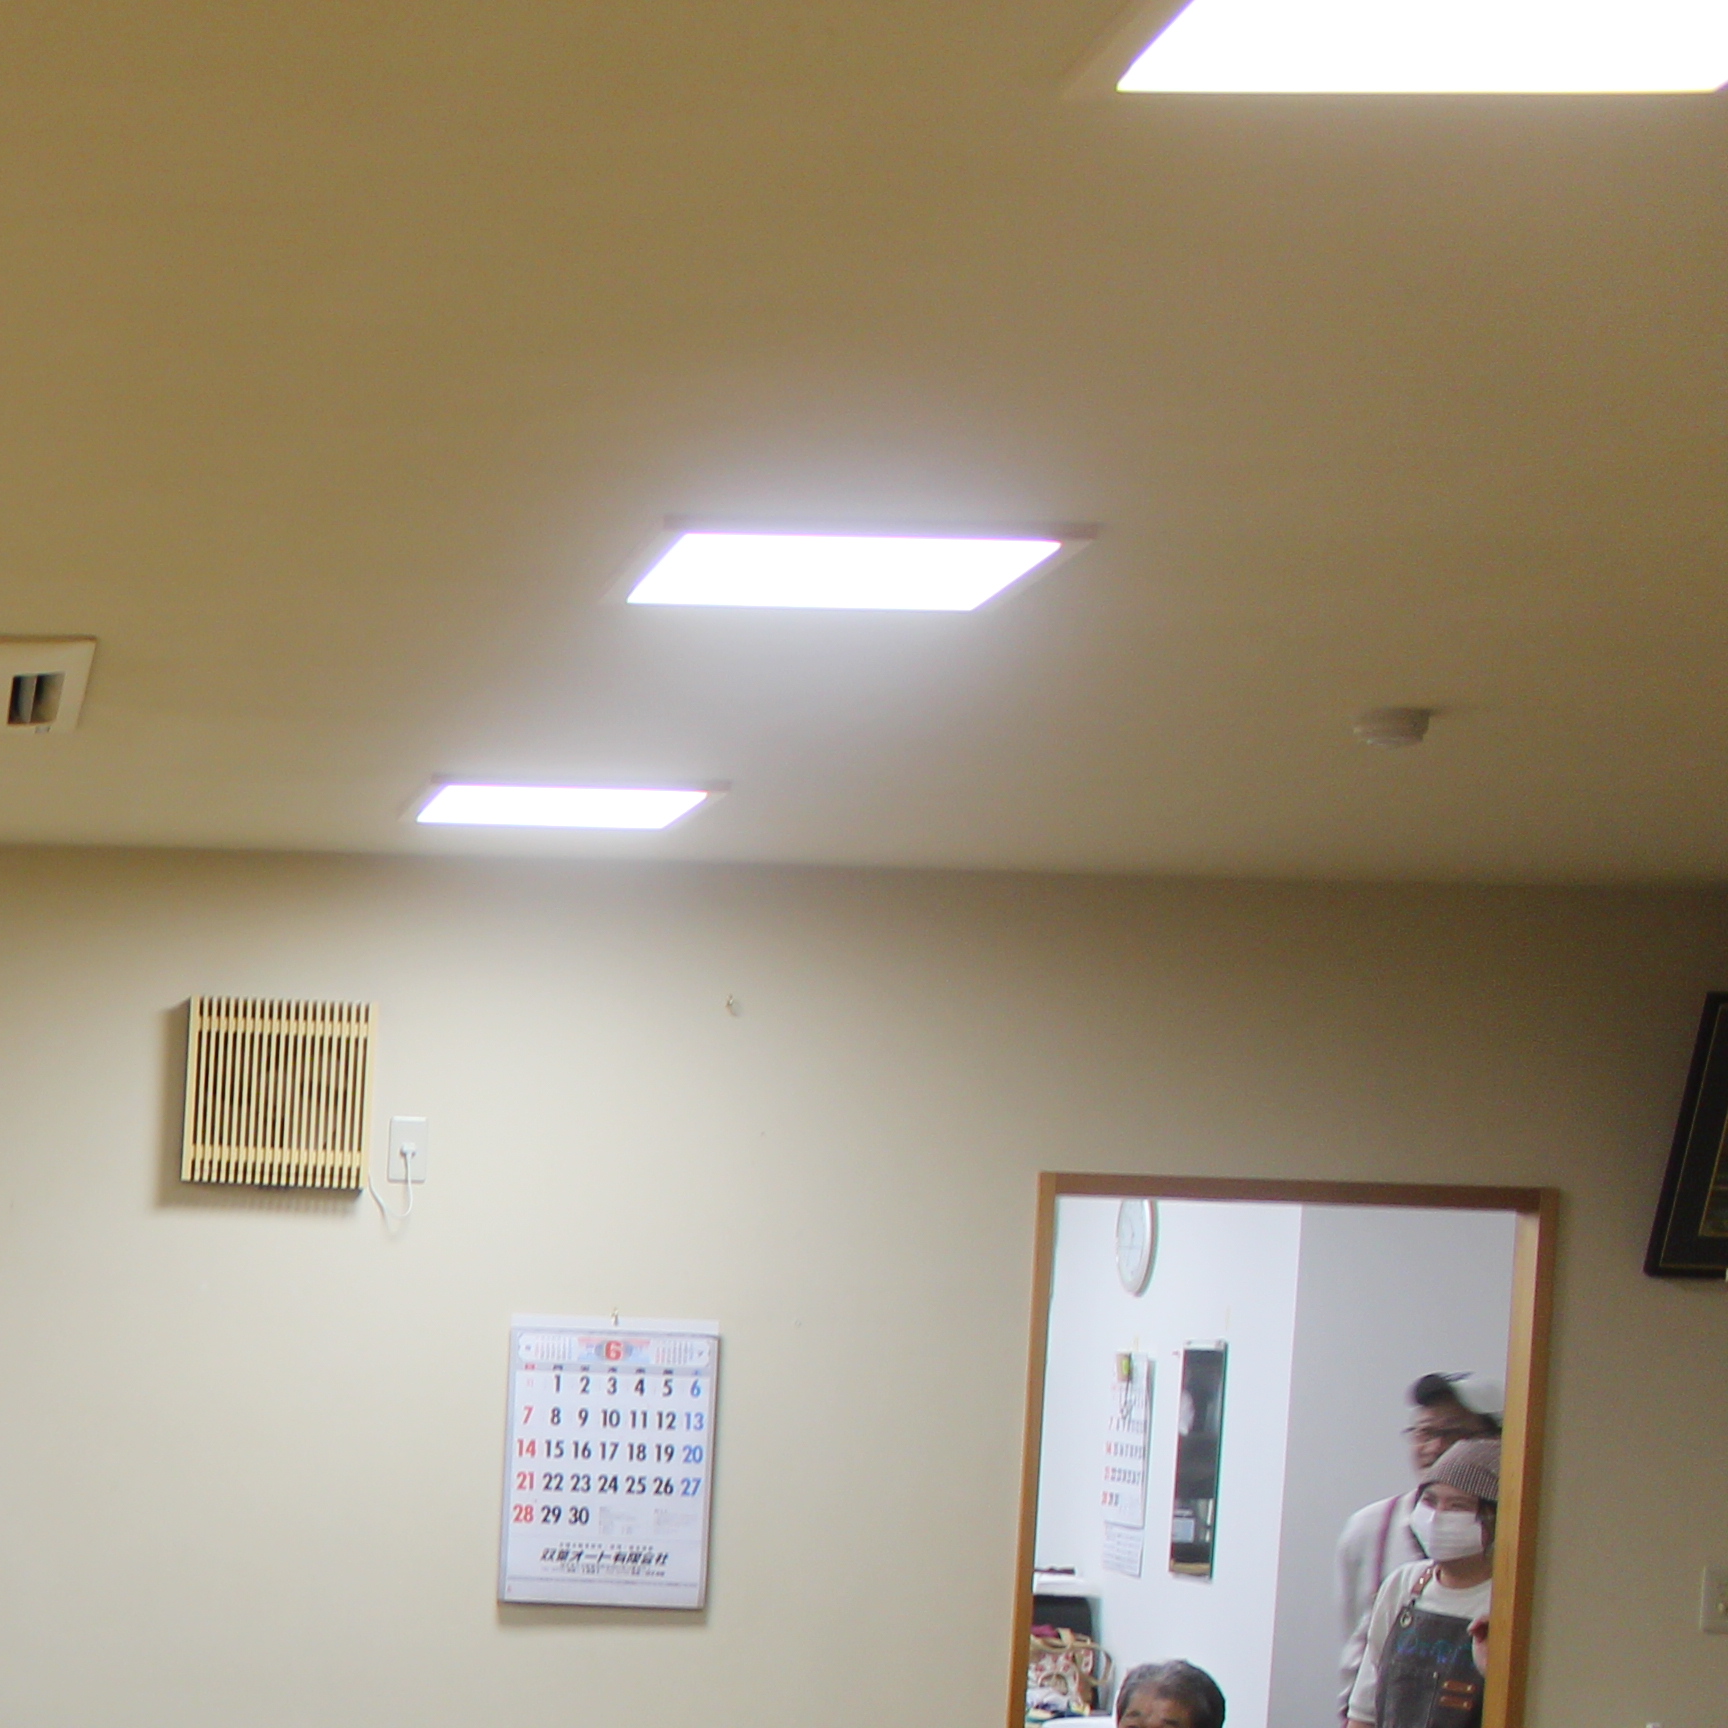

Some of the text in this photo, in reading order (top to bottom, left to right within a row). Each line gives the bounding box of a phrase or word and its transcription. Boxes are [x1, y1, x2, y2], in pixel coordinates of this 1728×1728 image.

[604, 1339, 624, 1362] 6
[553, 1374, 562, 1394] 1
[578, 1375, 592, 1395] 2
[606, 1376, 619, 1396] 3
[634, 1377, 647, 1397] 4
[662, 1378, 674, 1398] 5
[690, 1379, 703, 1398] 6
[522, 1405, 705, 1431] 7 8 9 10 11 12 13
[517, 1438, 704, 1464] 14 15 16 17 18 19 20
[516, 1471, 703, 1497] 21 22 23 24 25 26 27
[512, 1504, 535, 1524] 28
[540, 1505, 563, 1525] 29
[567, 1506, 590, 1527] 30
